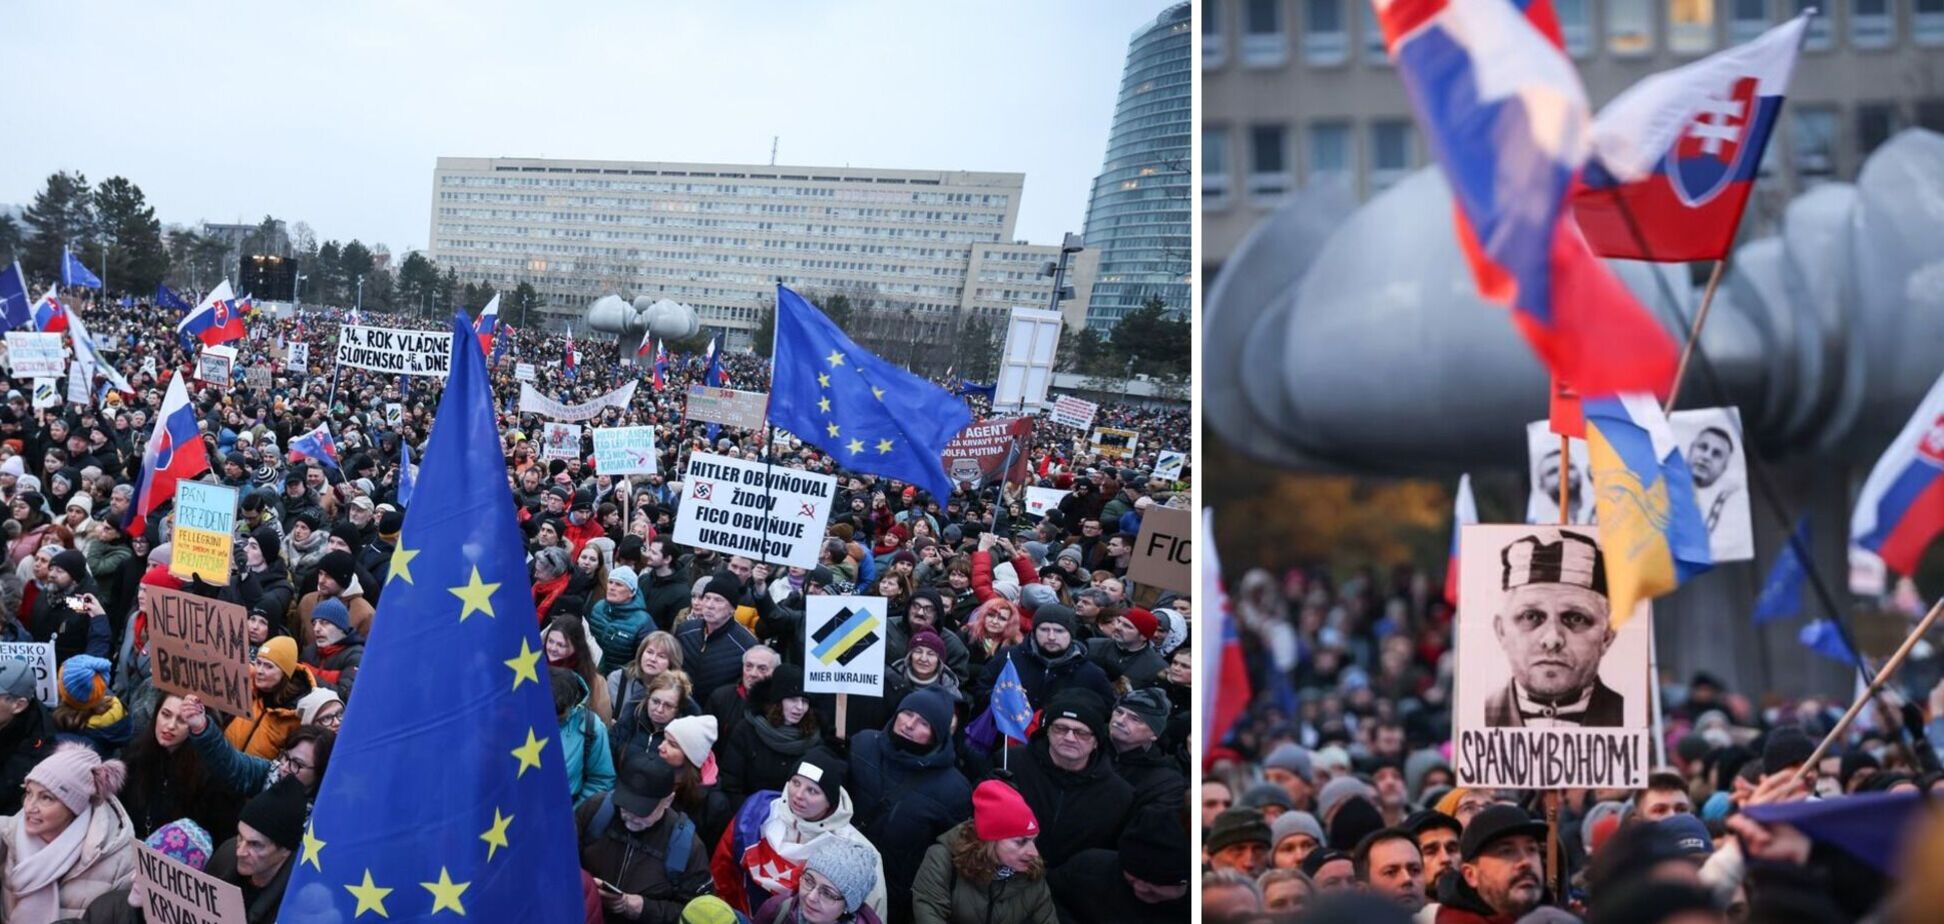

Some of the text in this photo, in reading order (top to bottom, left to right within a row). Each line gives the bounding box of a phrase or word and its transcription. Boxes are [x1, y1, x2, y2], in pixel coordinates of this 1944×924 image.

[345, 327, 361, 346] 14.
[367, 331, 393, 350] ROK
[339, 345, 449, 372] SLOVENSKO JE NA DNE
[952, 439, 961, 447] ZA
[966, 424, 1008, 438] AGENT
[968, 446, 1004, 457] PUTINA
[690, 460, 828, 498] HITLER OBVIŇOVAL
[730, 487, 778, 511] ŽIDOV
[179, 505, 232, 531] PREZIDENT
[695, 506, 805, 539] FICO OBVIŇUJE
[178, 530, 222, 547] PELLEGRINI
[698, 528, 793, 559] UKRAJINCOV
[151, 594, 245, 665] NEUTEKAM
[157, 646, 251, 718] BOJUJEM!
[809, 671, 879, 685] MIER UKRAJINE
[138, 847, 222, 918] NECHCEME
[147, 887, 218, 924] KRVA
